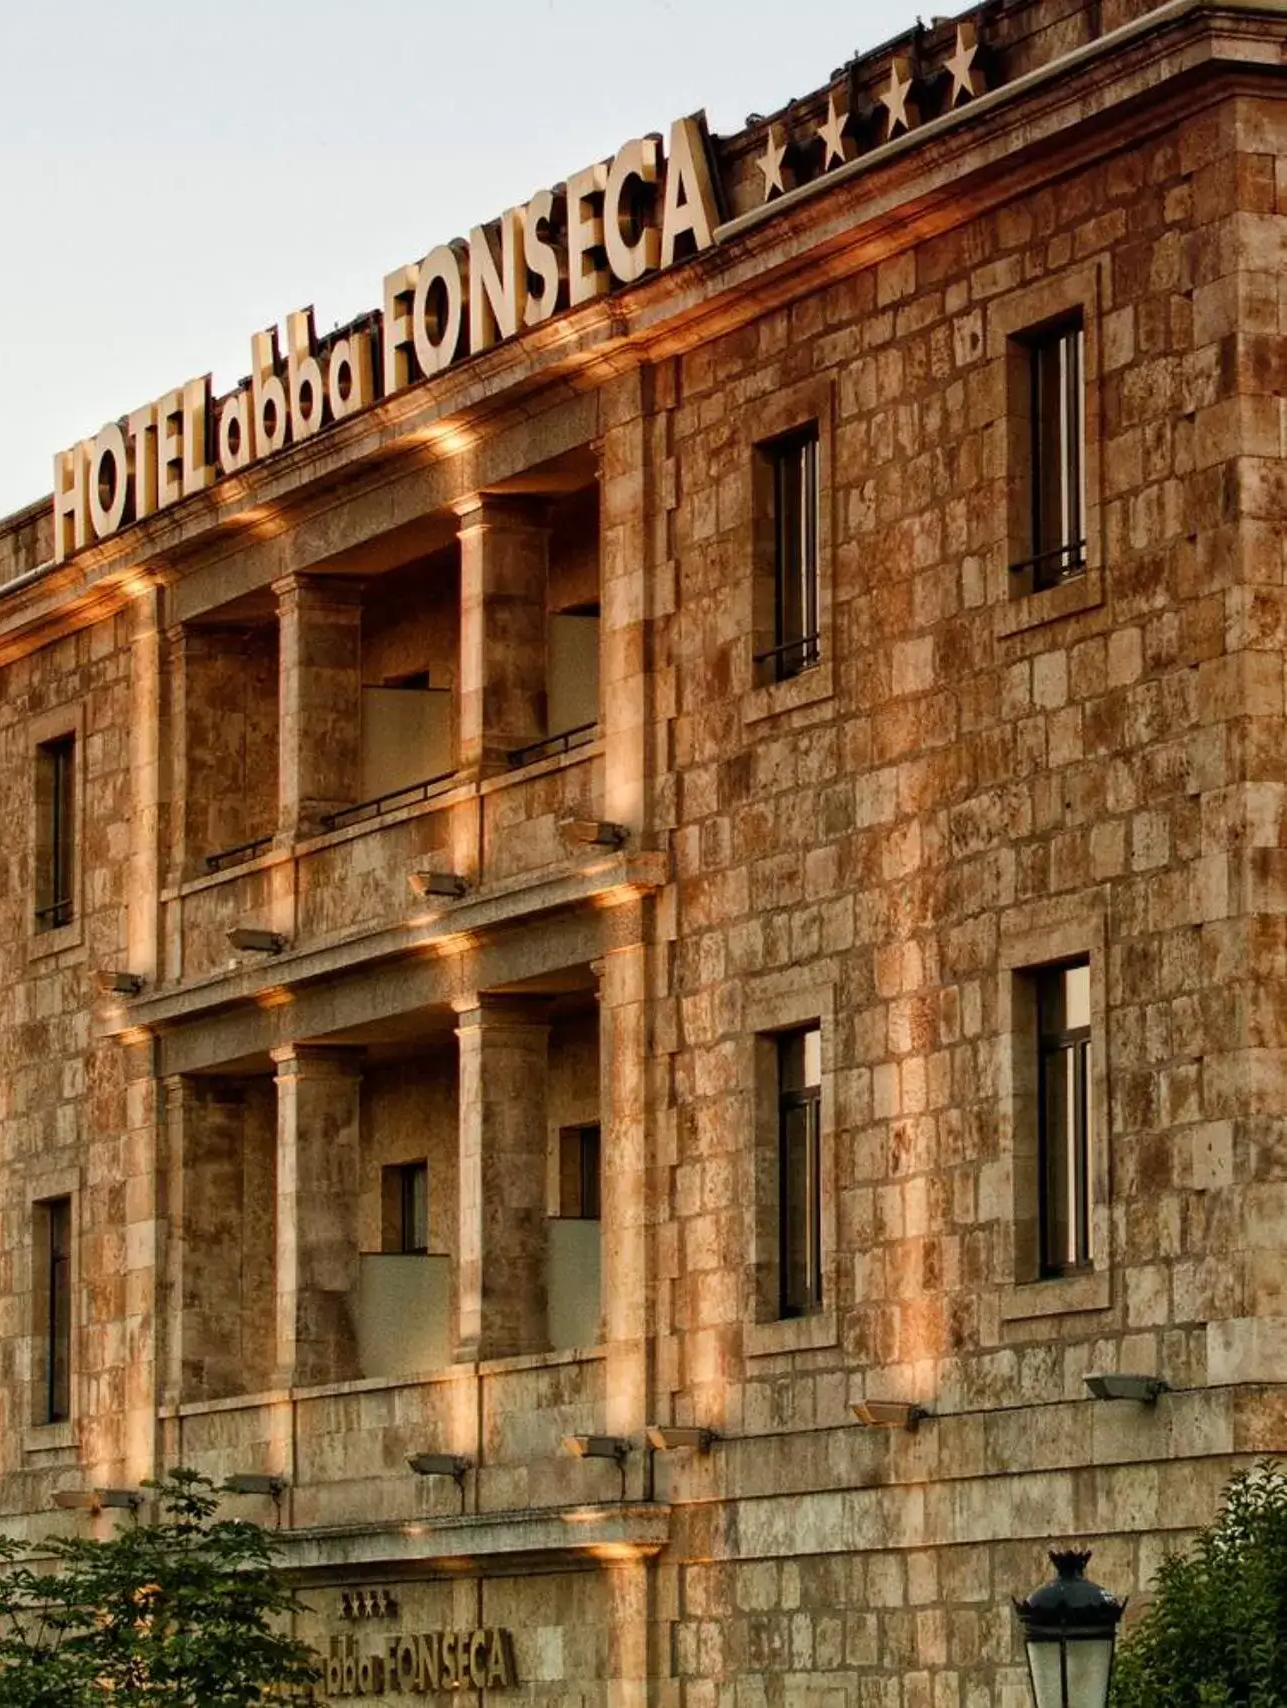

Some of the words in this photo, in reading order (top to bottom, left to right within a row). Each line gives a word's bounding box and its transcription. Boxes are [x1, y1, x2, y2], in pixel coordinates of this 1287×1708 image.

[53, 374, 213, 563] HOTEL
[219, 305, 374, 474] abba
[383, 108, 715, 396] FONSECA
[382, 1627, 513, 1693] FONSECA
